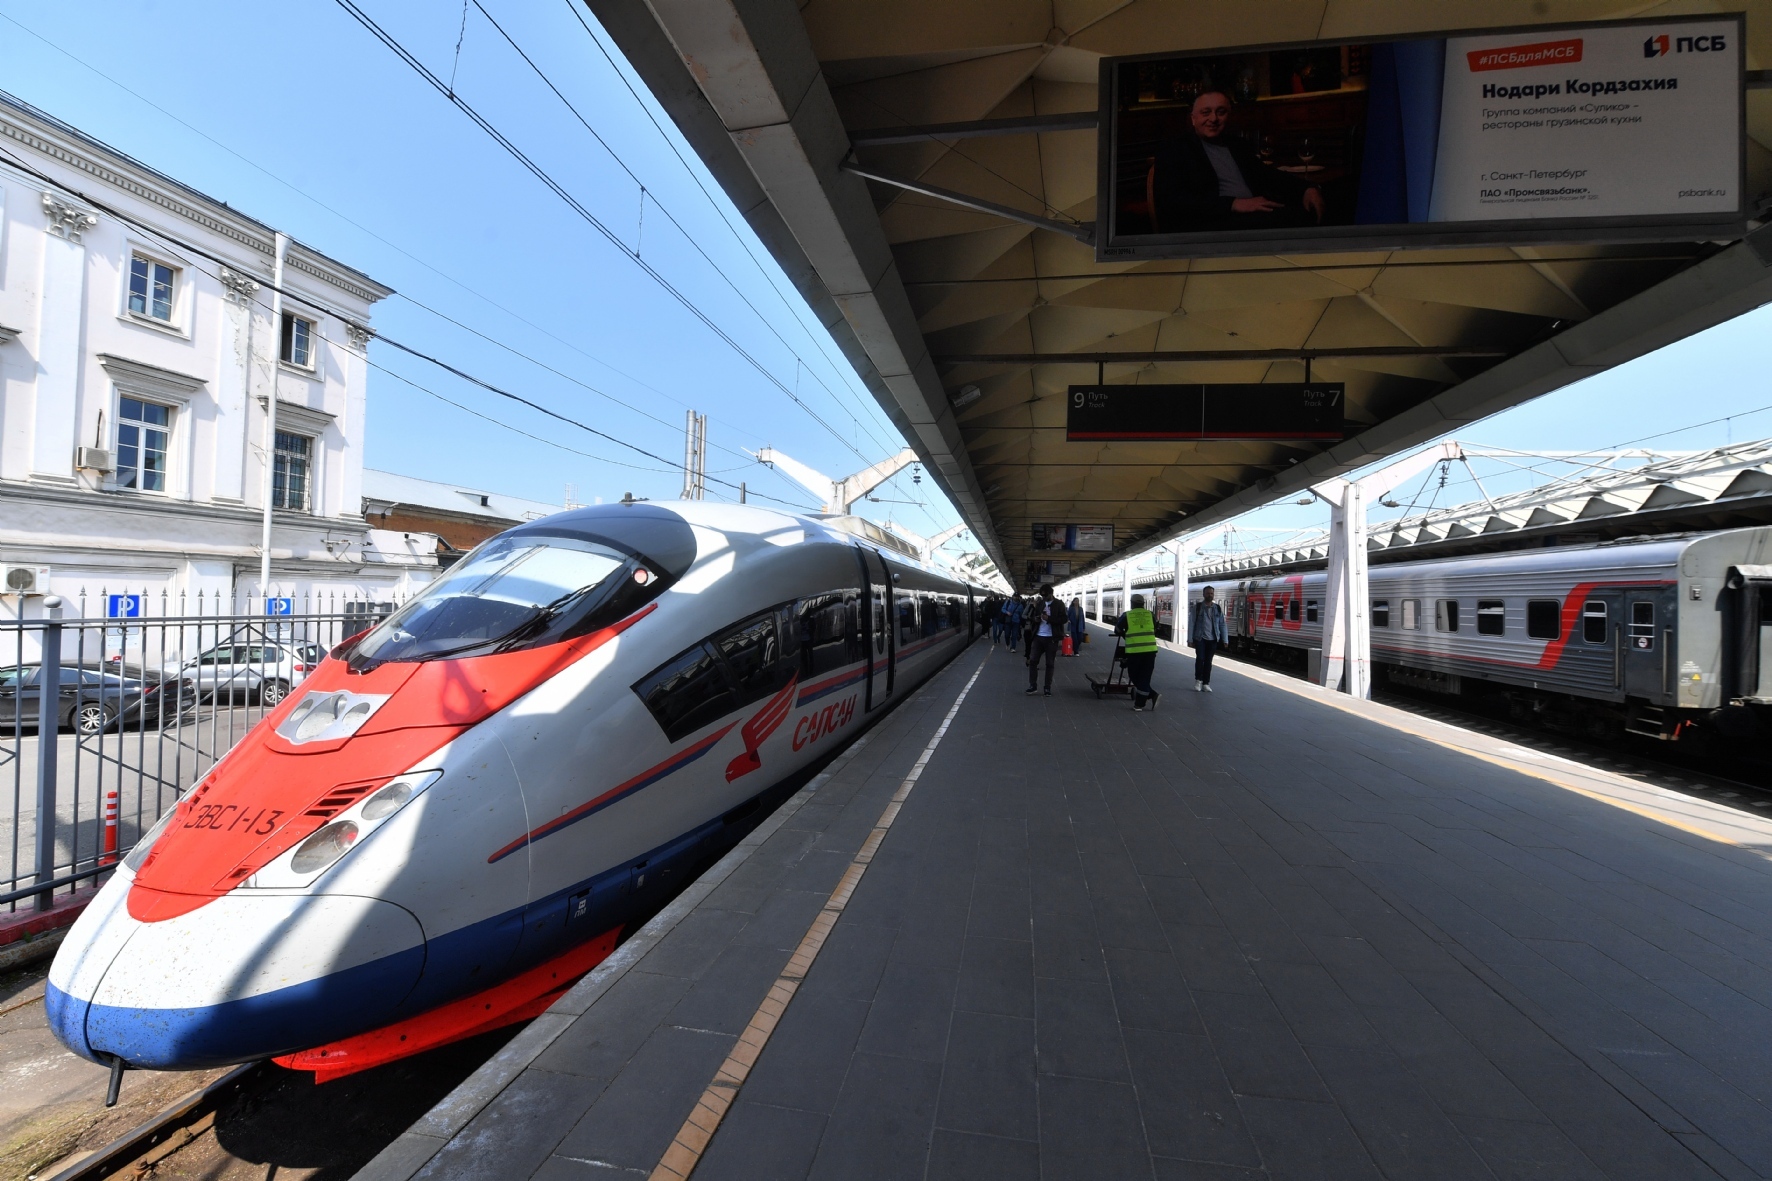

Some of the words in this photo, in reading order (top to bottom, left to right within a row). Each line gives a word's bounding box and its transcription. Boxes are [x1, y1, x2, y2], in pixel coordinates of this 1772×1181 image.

[1676, 35, 1726, 53] ПСБ
[1479, 46, 1575, 66] #ПСБдляМСБ
[1482, 82, 1560, 99] Нодари
[1565, 77, 1678, 96] Кордзахия
[1482, 107, 1520, 120] Группа
[1523, 104, 1577, 116] компаний
[1579, 102, 1630, 115] «Сулико»
[1482, 118, 1544, 131] рестораны
[1546, 115, 1608, 128] грузинской
[1610, 114, 1642, 125] кухни
[1490, 169, 1588, 181] Санкт-Петербург
[1480, 189, 1502, 197] ПАО
[1678, 188, 1726, 199] psbank.ru
[1074, 392, 1085, 409] 9
[1088, 391, 1109, 401] Путь
[1303, 389, 1326, 399] Путь
[1328, 390, 1341, 407] 7
[792, 693, 858, 752] САПСАН
